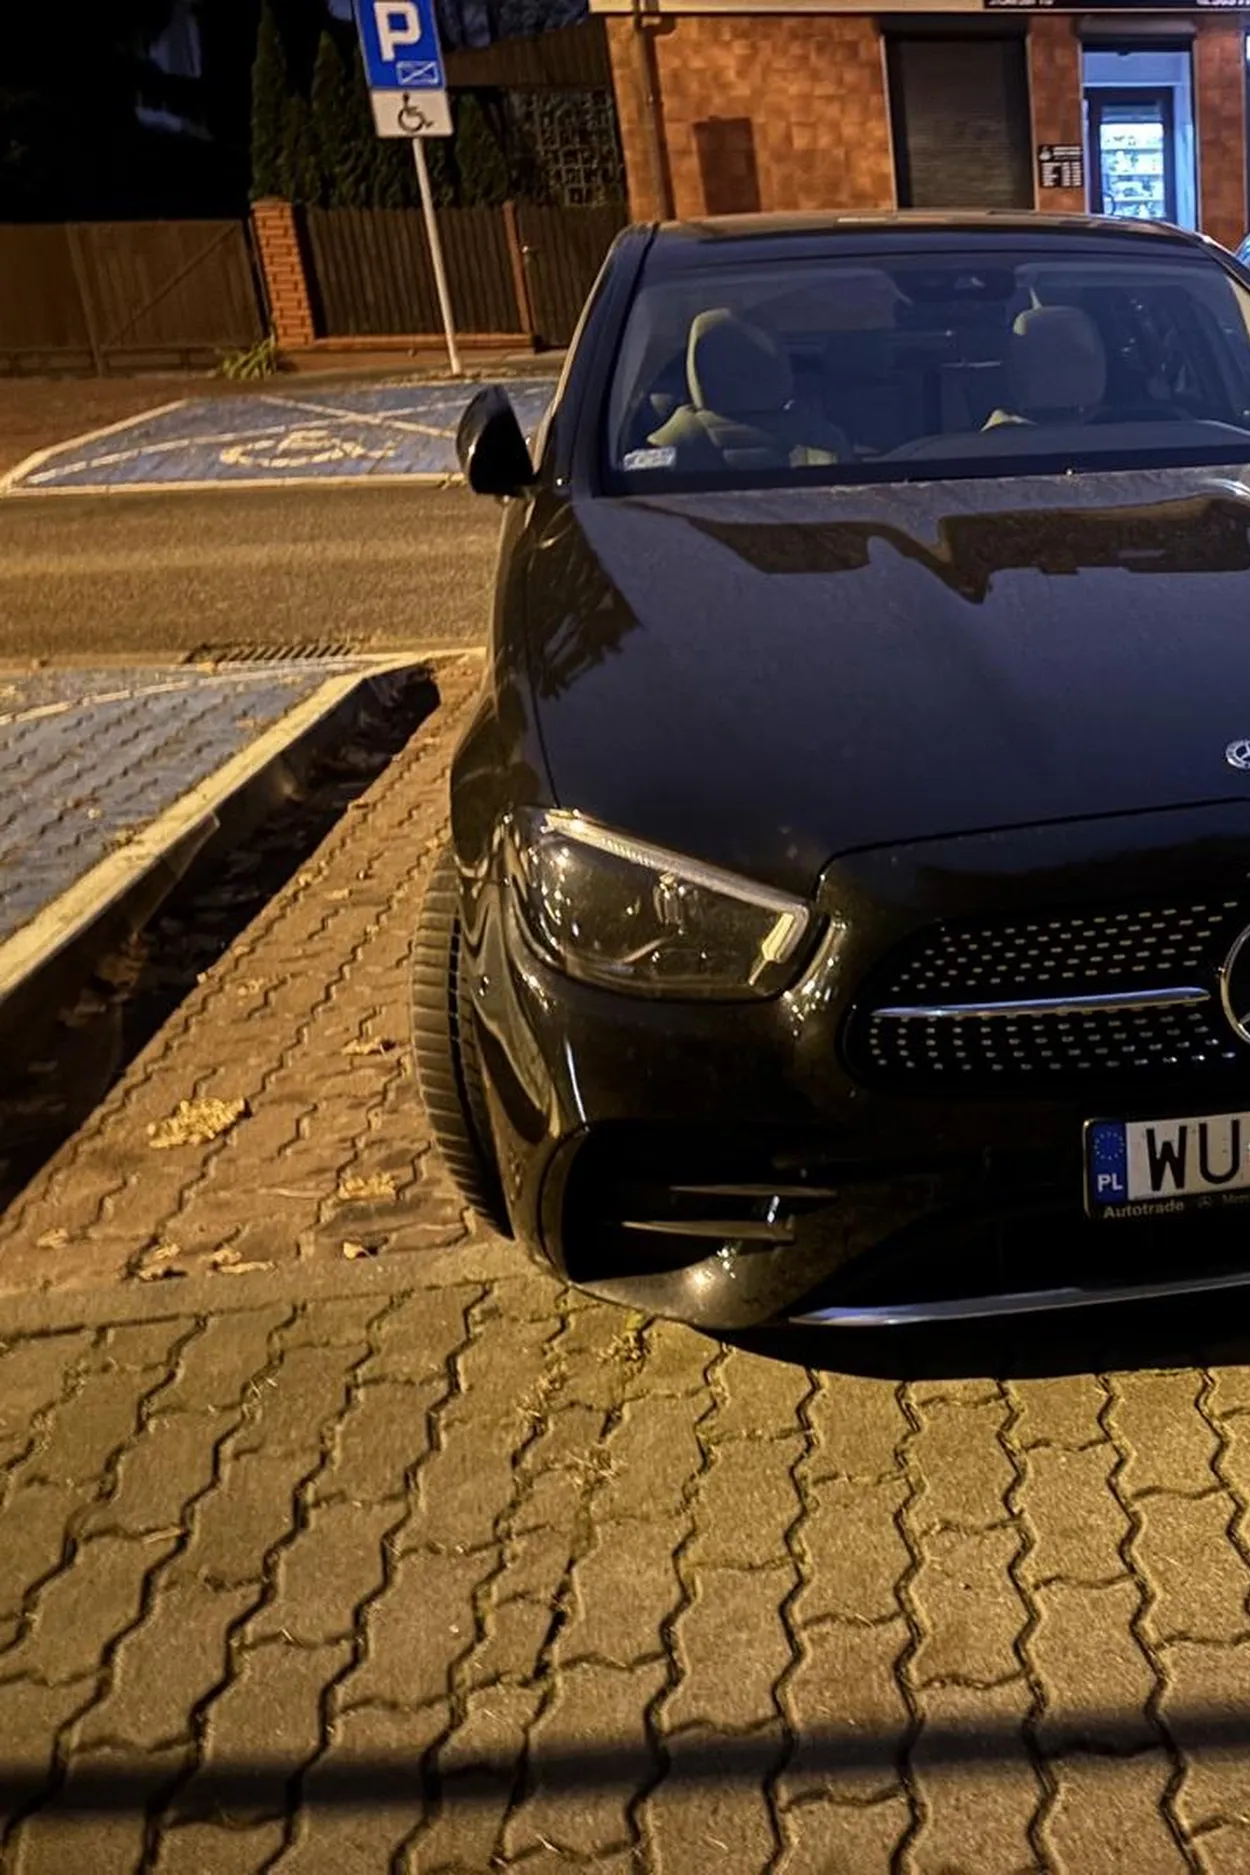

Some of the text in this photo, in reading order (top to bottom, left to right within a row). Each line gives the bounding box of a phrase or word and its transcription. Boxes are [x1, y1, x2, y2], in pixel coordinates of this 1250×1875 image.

[373, 1, 421, 61] P
[1145, 1119, 1241, 1192] WU
[1097, 1174, 1124, 1192] PL
[1102, 1199, 1185, 1220] Autotrade
